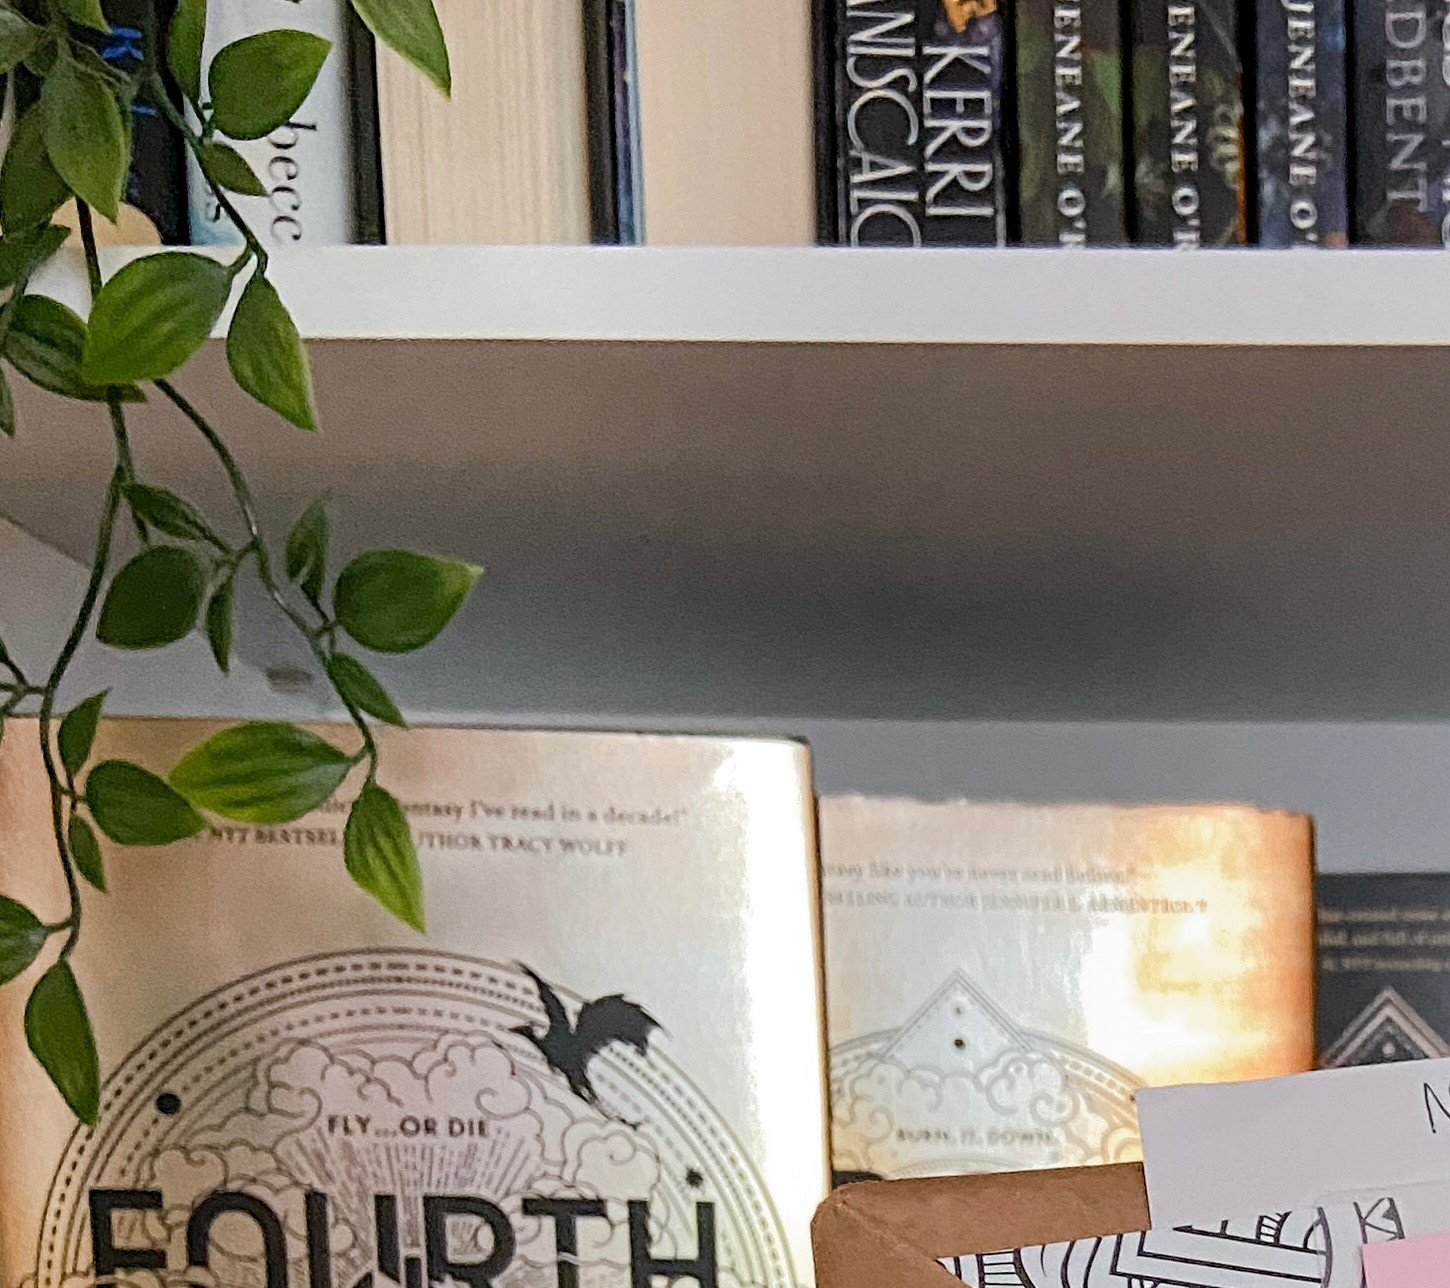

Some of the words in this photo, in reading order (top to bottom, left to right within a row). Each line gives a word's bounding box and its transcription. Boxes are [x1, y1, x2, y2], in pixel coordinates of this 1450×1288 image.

[846, 0, 922, 245] NISCALC
[923, 45, 996, 218] KERRI
[1053, 0, 1086, 174] ENEANE
[1384, 0, 1428, 212] DBENT
[418, 832, 485, 853] THOR
